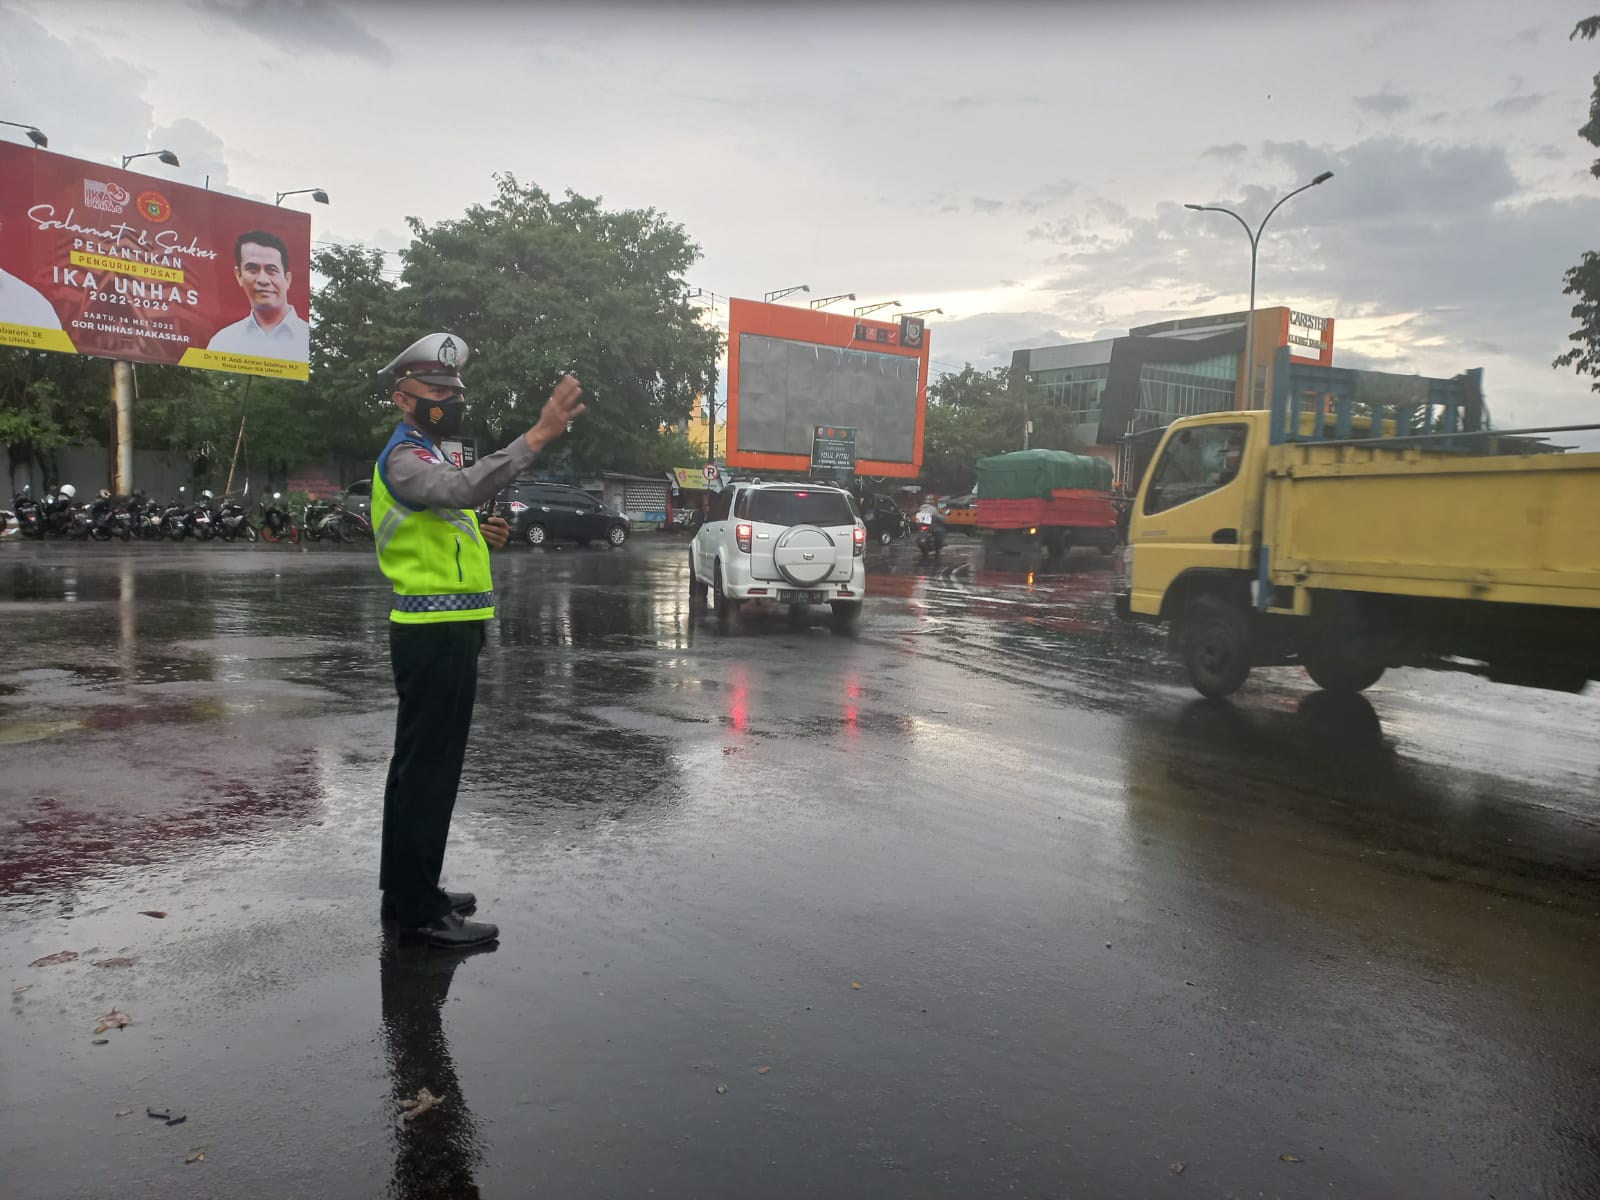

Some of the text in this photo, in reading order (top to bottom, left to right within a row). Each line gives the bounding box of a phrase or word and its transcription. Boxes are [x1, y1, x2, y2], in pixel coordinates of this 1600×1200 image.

[85, 199, 123, 214] UNHAS
[86, 187, 111, 203] IKA
[27, 203, 217, 260] Selamat & Sukses
[73, 238, 182, 269] PELANTIKAN
[78, 254, 177, 280] PENGURUS PUSAT
[53, 265, 199, 305] IKA UNHAS
[89, 290, 169, 311] 2022-2026
[71, 320, 190, 343] GOR UNHAS MAKASSAR
[119, 316, 128, 324] 14
[132, 319, 149, 327] MEI
[152, 321, 174, 330] 2022
